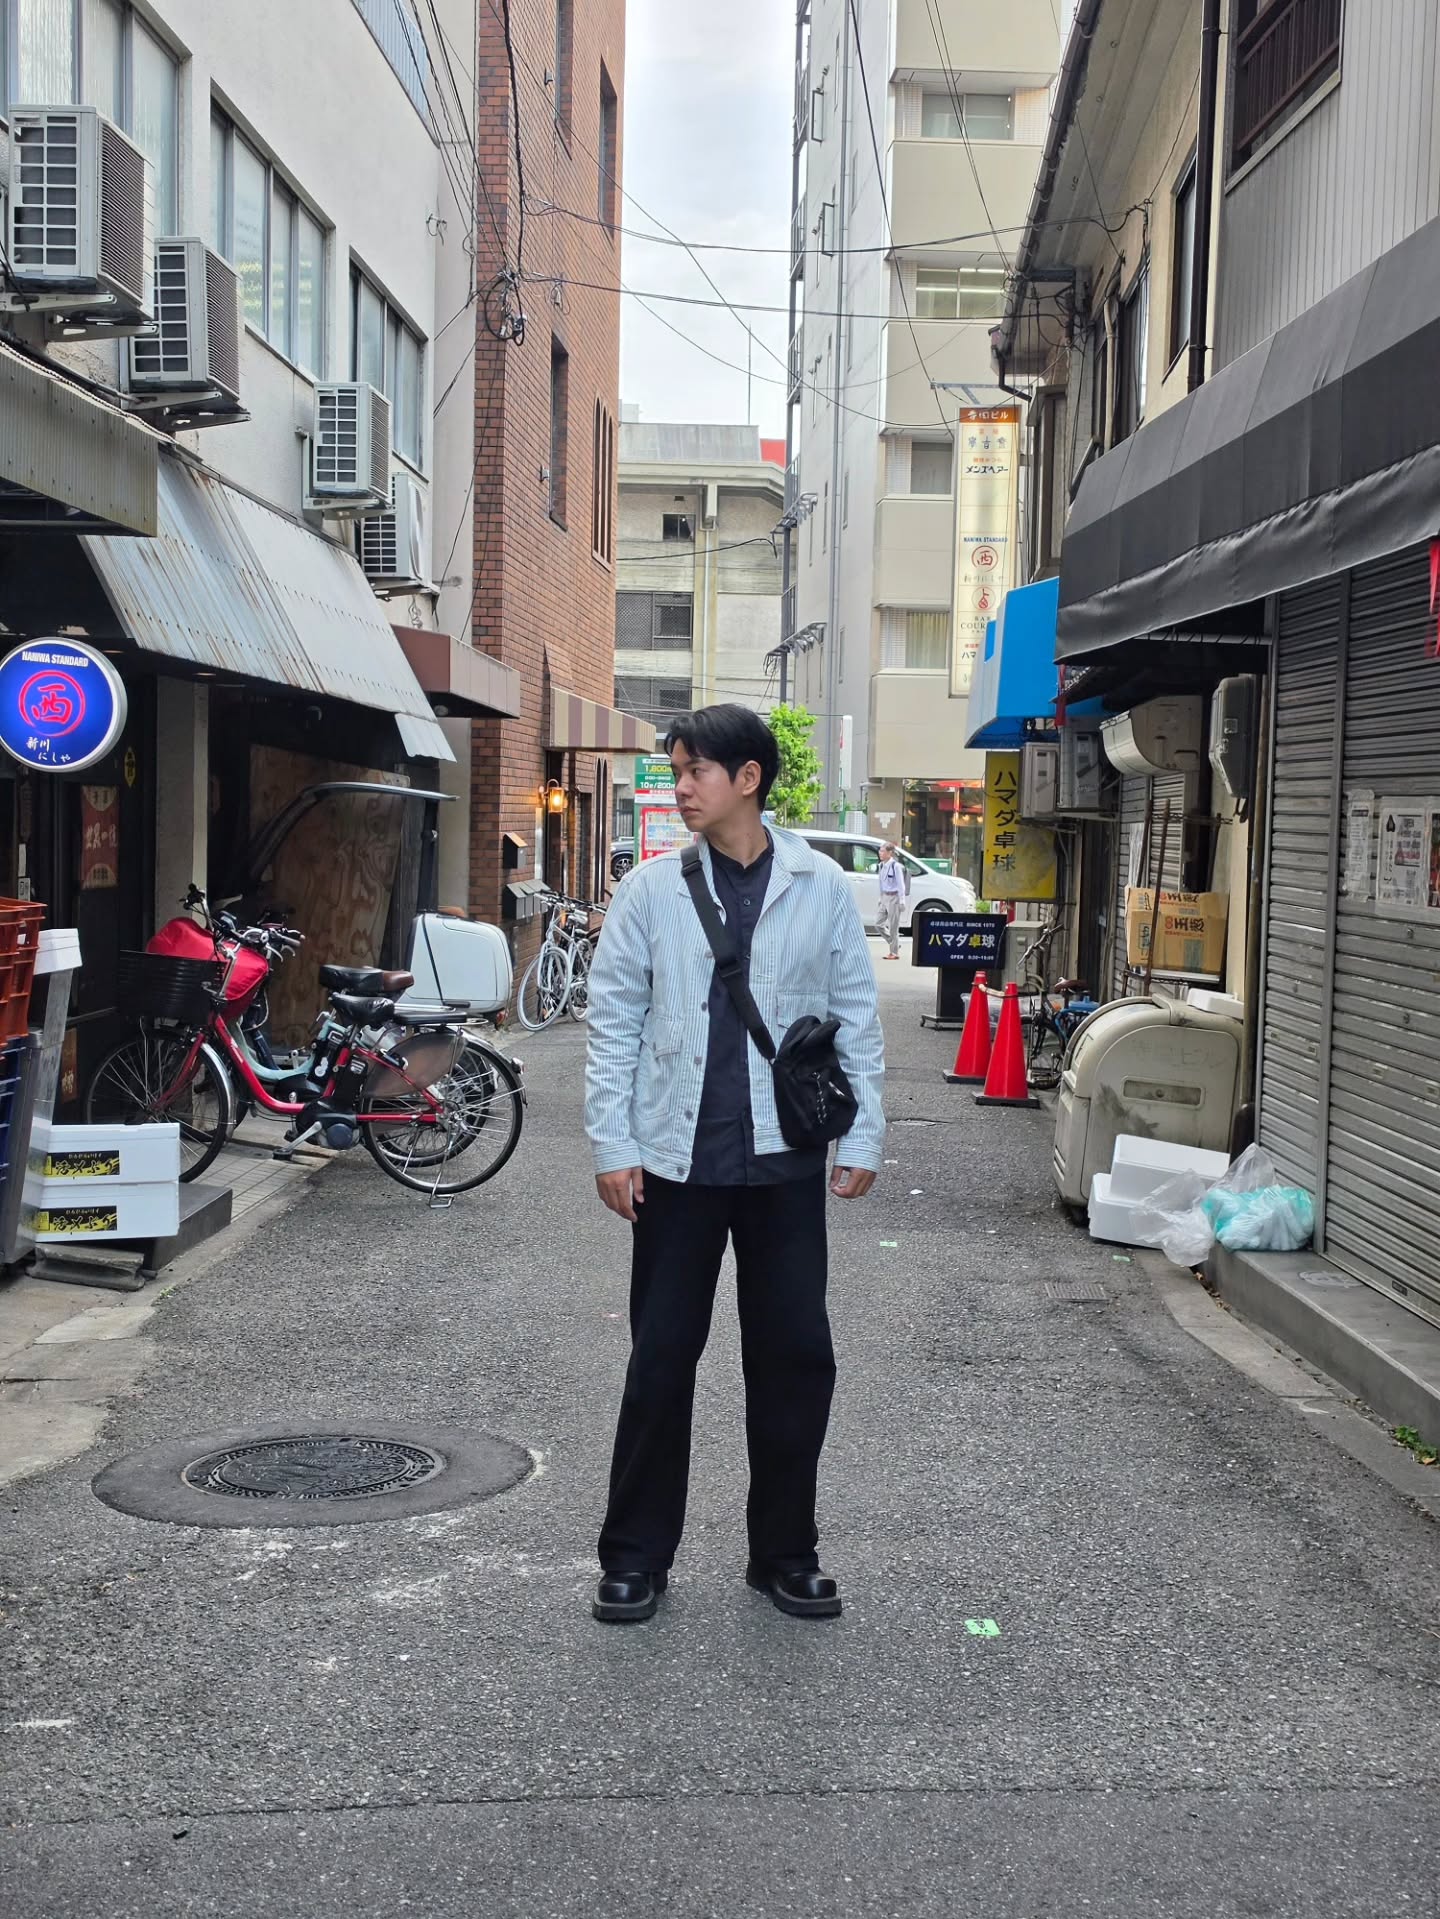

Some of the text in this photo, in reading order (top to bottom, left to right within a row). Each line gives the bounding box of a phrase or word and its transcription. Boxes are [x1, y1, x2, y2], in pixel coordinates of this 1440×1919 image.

[21, 651, 89, 667] NANIWA STANDARD
[26, 736, 51, 752] 新川
[38, 752, 71, 763] にしや
[993, 770, 1017, 872] ハマダ卓球
[928, 933, 995, 948] ハマダ卓球
